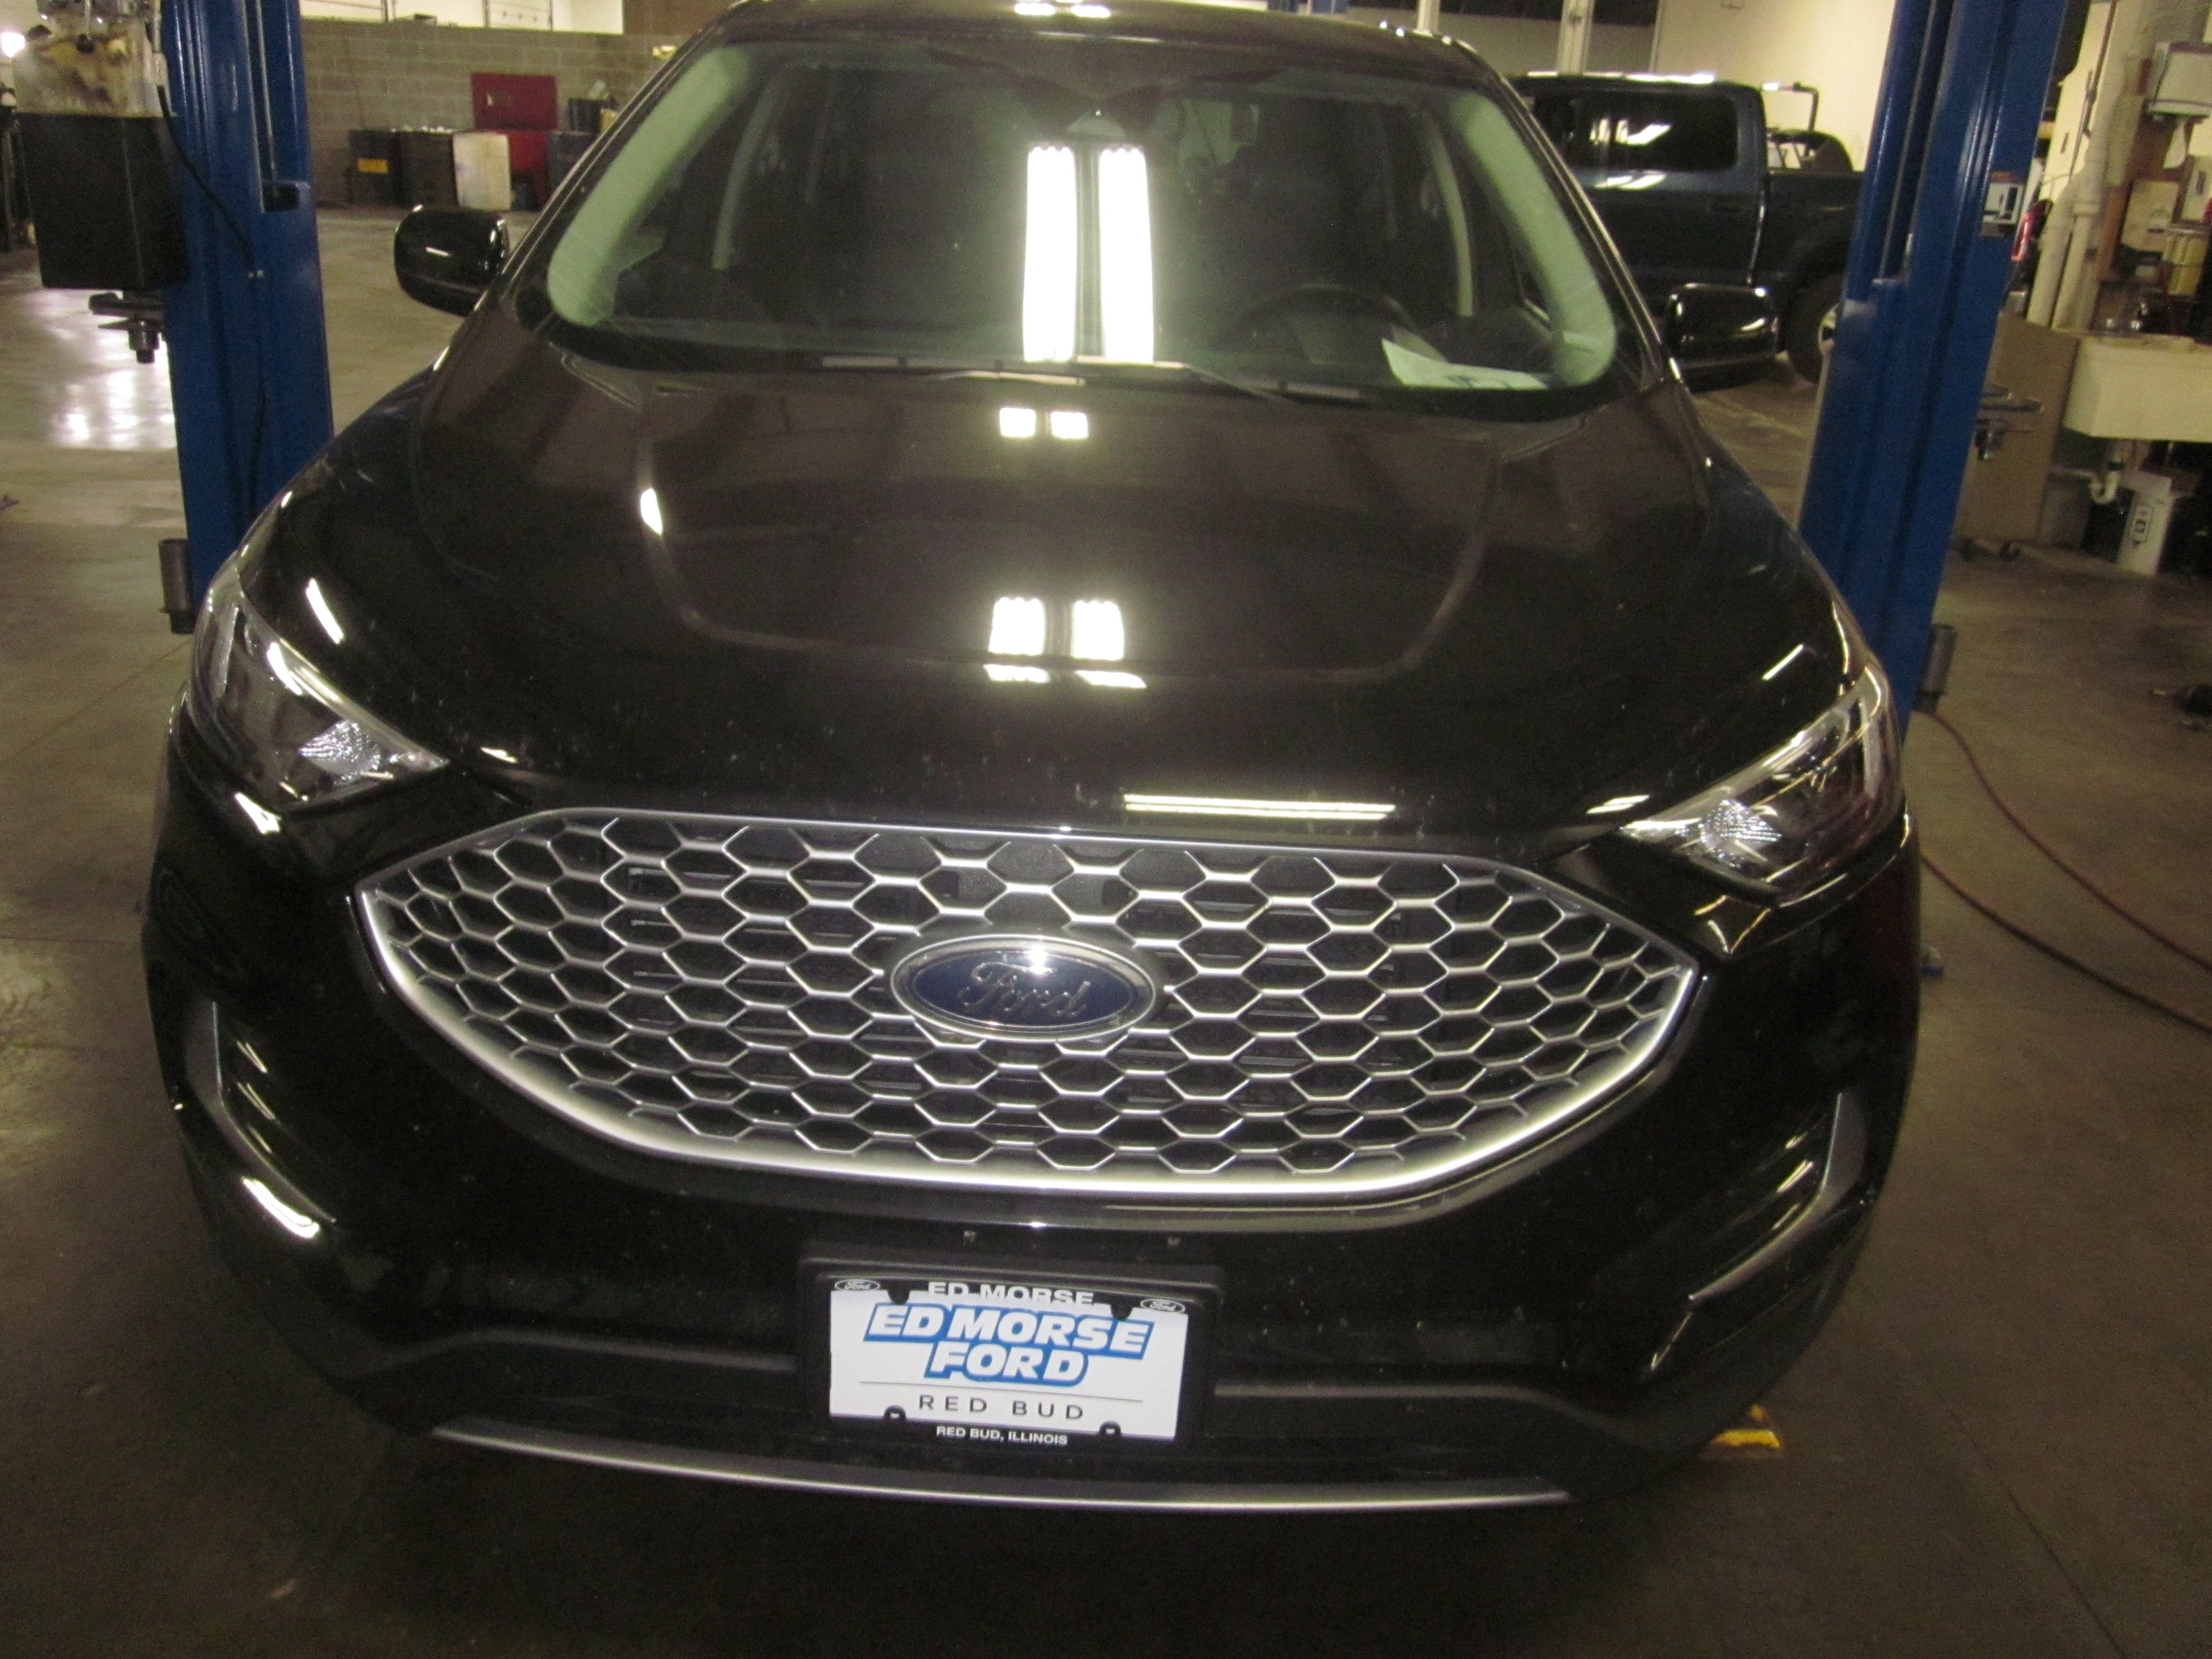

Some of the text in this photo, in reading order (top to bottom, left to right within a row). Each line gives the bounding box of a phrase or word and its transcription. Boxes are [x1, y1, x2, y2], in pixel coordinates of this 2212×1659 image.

[958, 961, 1091, 1018] Ford
[928, 1281, 1094, 1305] ED MORSE
[866, 1303, 1151, 1354] ED MORSE
[928, 1340, 1085, 1383] FORD
[919, 1394, 1083, 1420] RED BUD
[936, 1425, 1068, 1446] RED BUD, ILLINOIS
